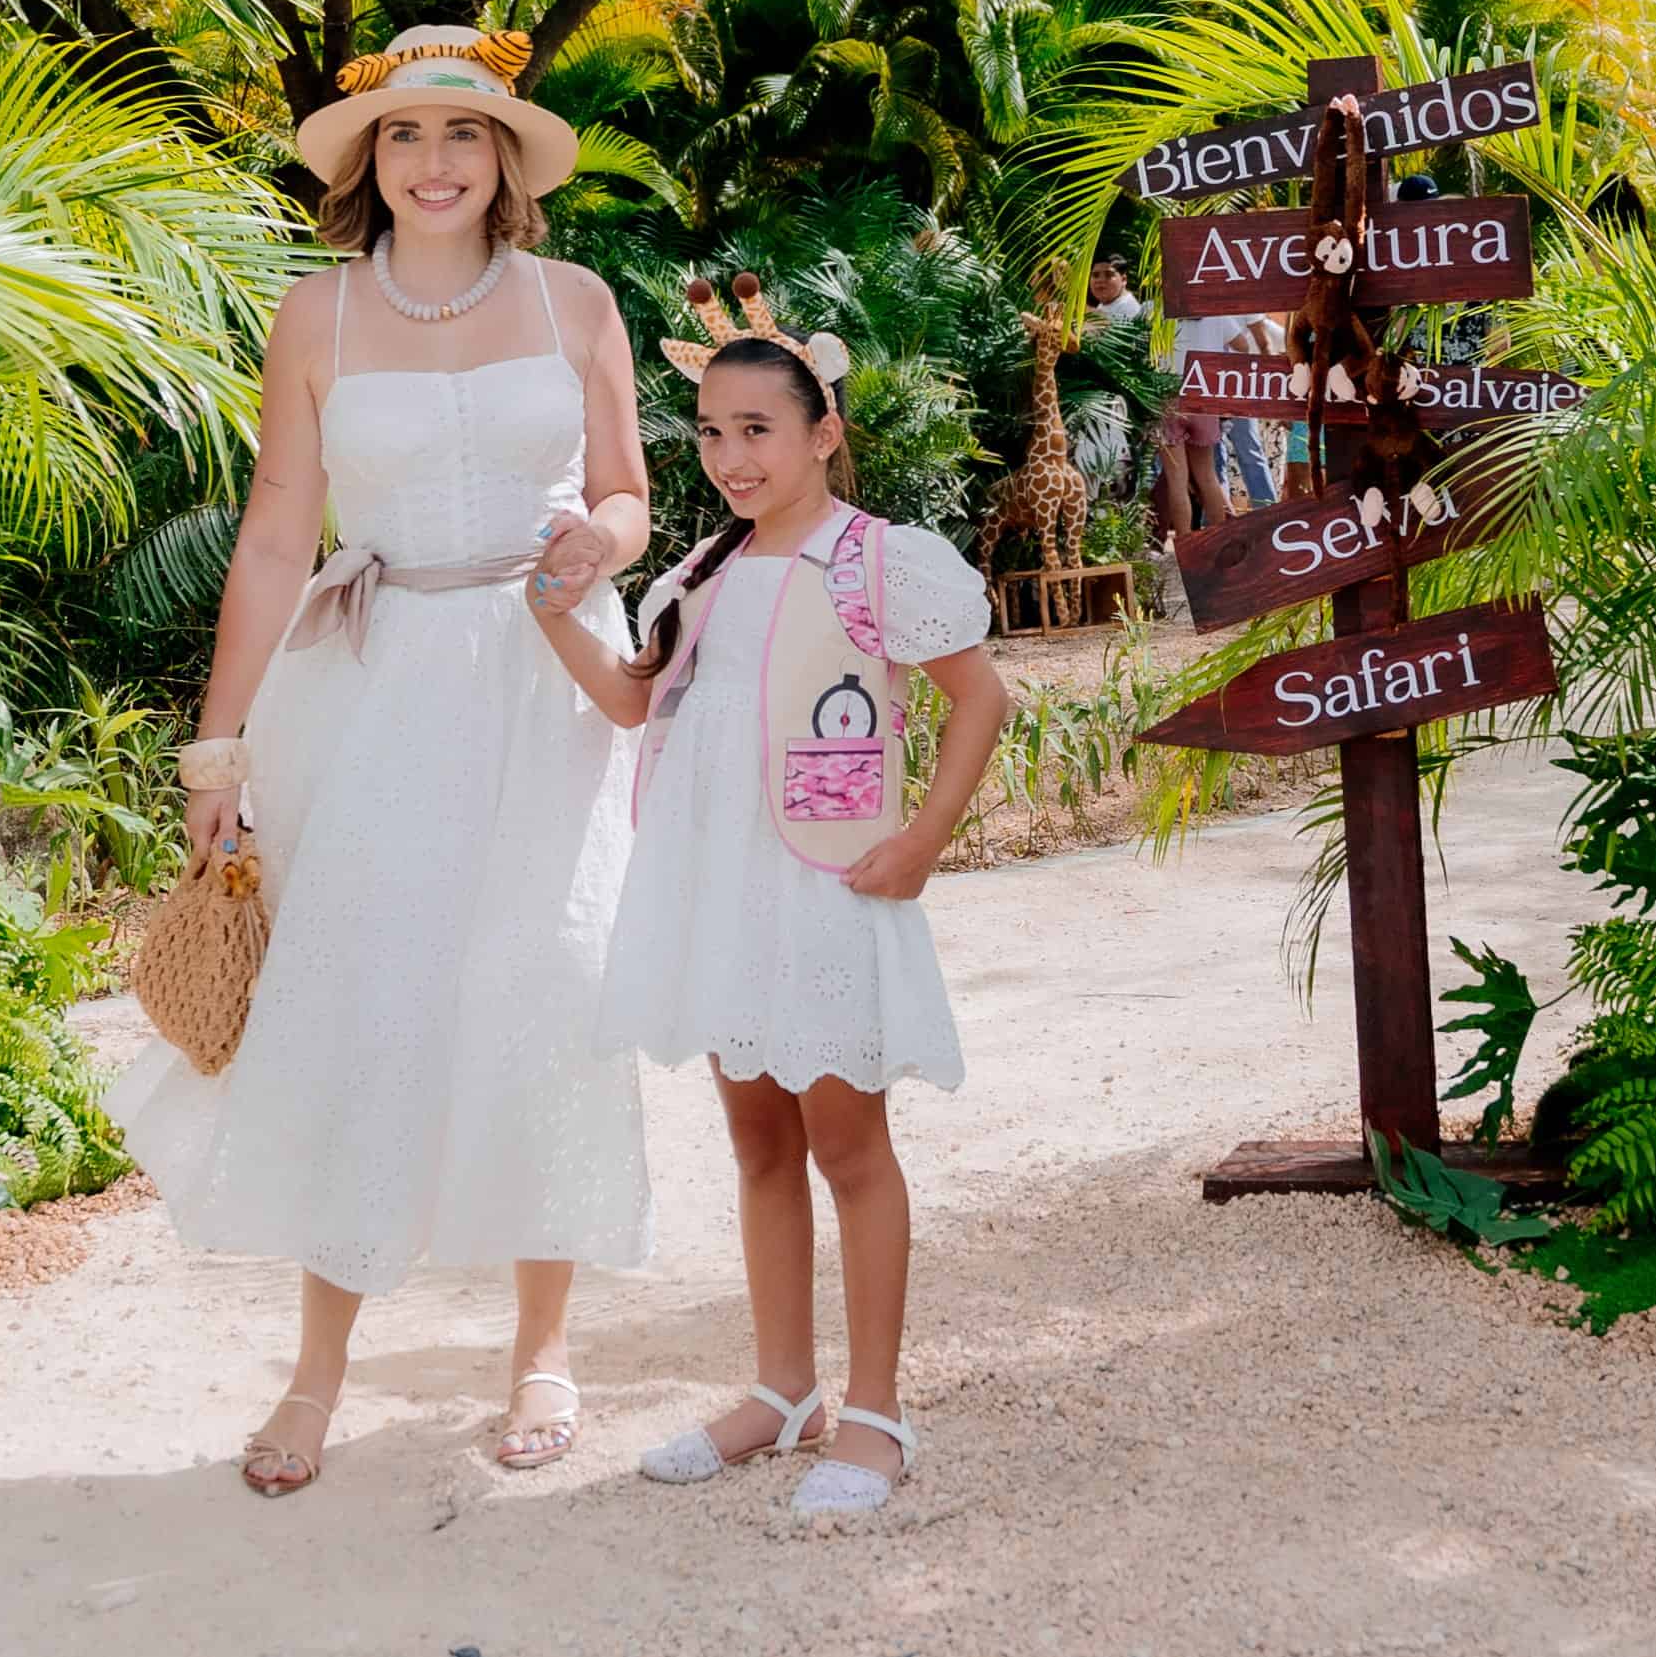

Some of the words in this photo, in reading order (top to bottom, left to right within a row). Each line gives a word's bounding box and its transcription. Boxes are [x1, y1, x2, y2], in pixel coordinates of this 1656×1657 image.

[1137, 76, 1538, 200] Bienvnidos
[1186, 217, 1511, 285] Avetura
[1273, 632, 1482, 728] Safari
